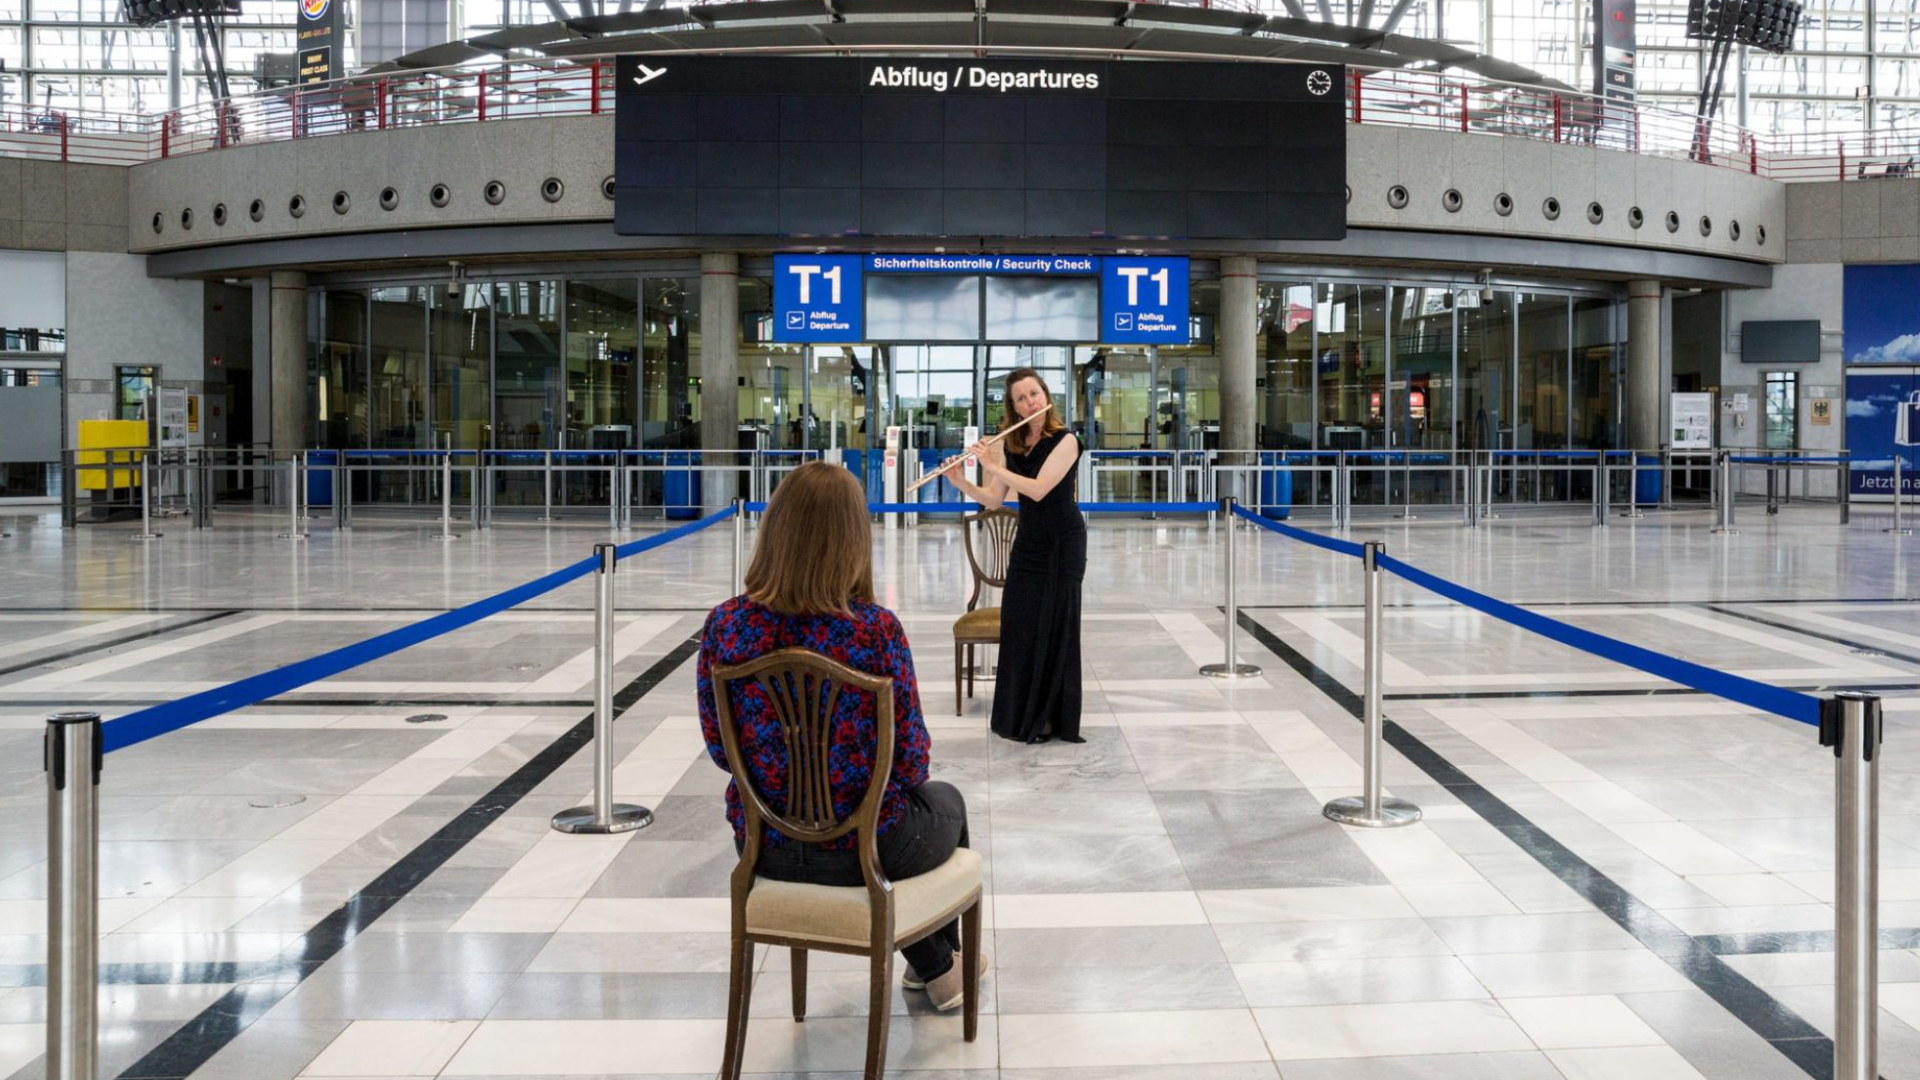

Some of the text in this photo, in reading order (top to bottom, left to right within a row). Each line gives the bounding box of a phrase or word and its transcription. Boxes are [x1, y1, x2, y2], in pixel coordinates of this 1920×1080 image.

[869, 66, 1099, 92] Abflug / Departures
[873, 258, 1091, 272] Sicherheitskontrolle / Security Check
[789, 265, 841, 304] T1
[1117, 267, 1169, 306] T1
[810, 311, 837, 321] Abflug
[1138, 312, 1164, 323] Abflug
[810, 321, 850, 331] Departure
[1138, 323, 1177, 332] Departure
[1860, 474, 1895, 488] Jetzt
